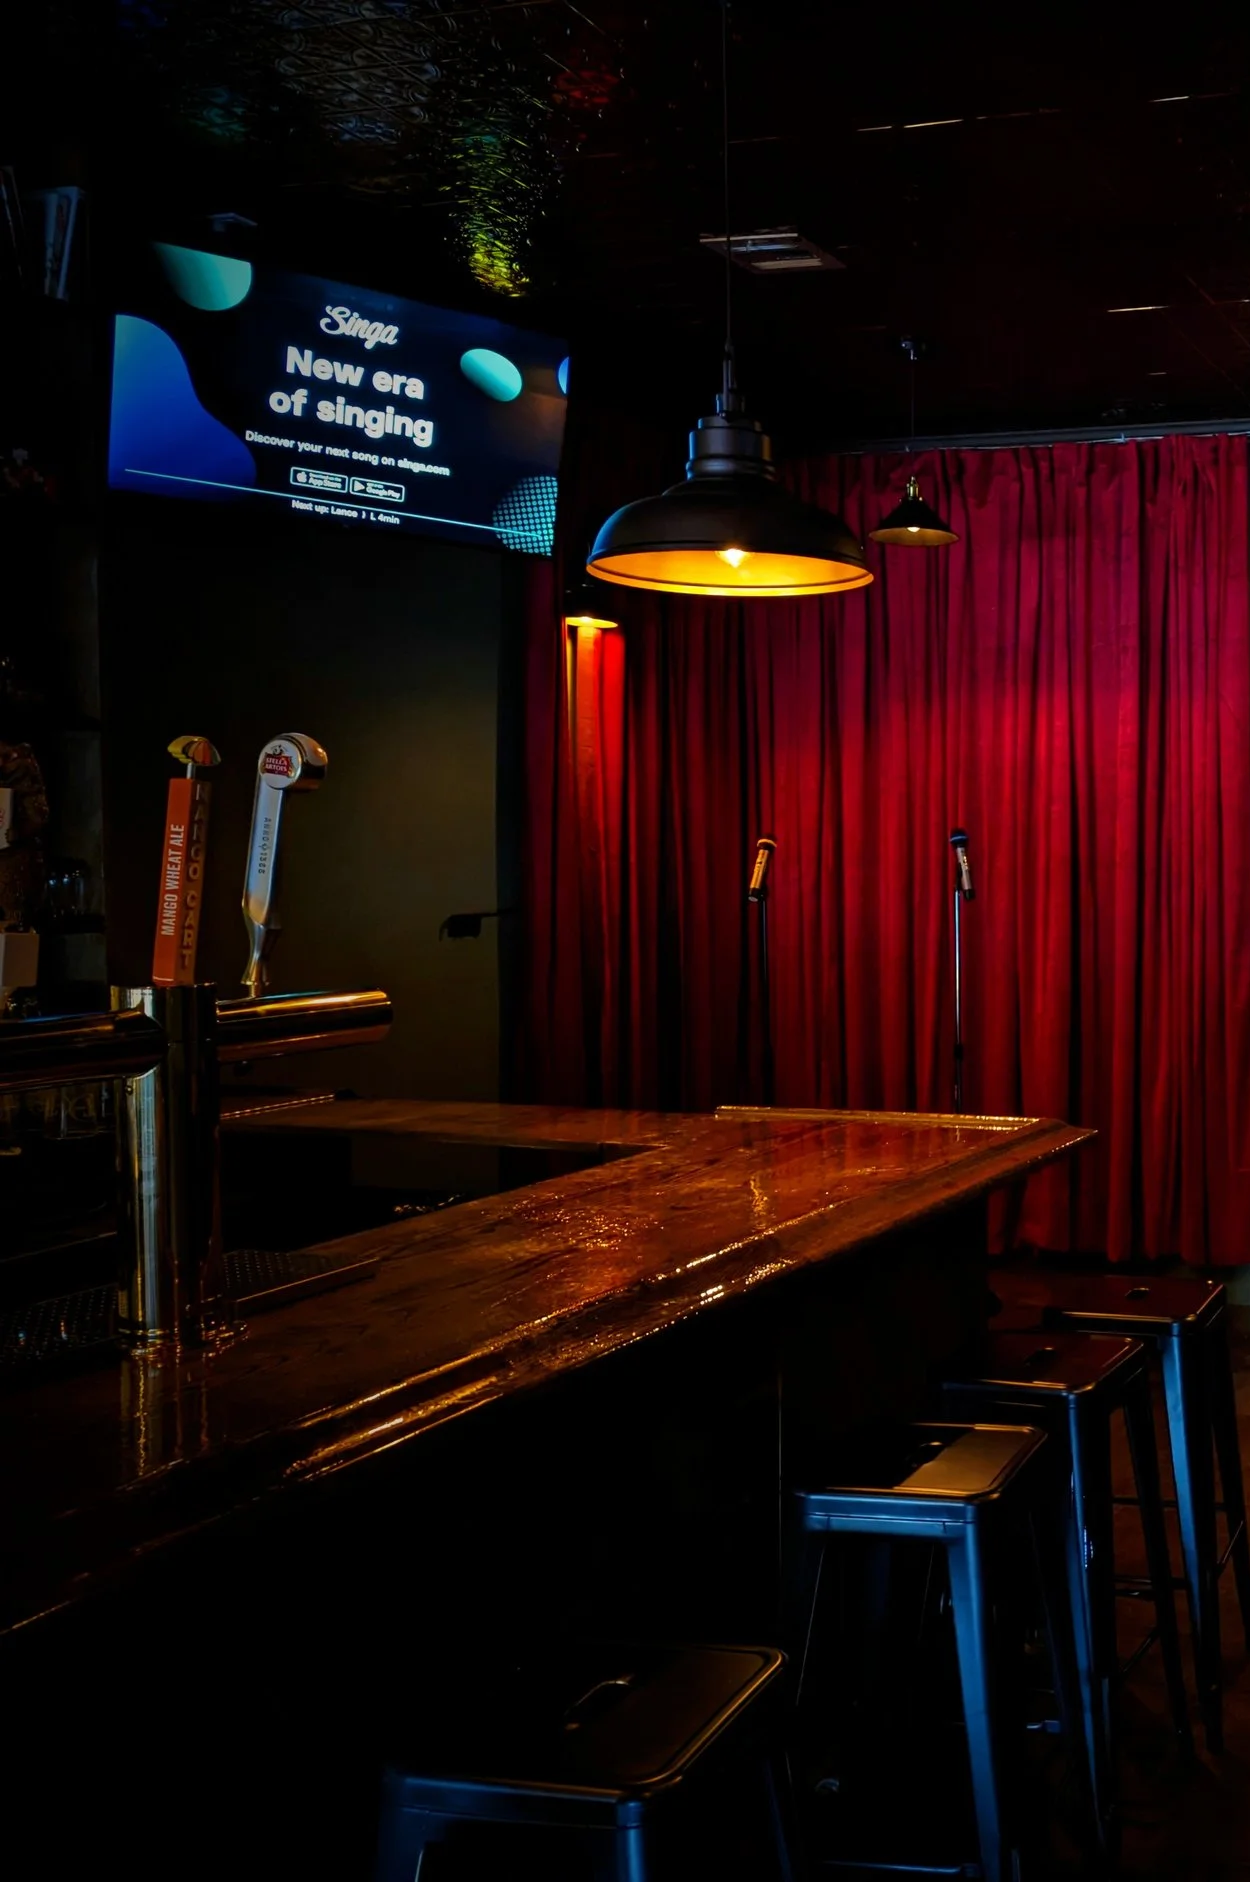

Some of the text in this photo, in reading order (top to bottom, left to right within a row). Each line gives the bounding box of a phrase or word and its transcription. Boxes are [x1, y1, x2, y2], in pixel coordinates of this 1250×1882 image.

[319, 305, 399, 350] Singa
[285, 345, 425, 400] New era
[268, 388, 434, 447] of singing
[245, 430, 450, 476] Discover your next song on singa.com
[291, 499, 313, 511] Next
[331, 506, 358, 518] Lance
[160, 824, 185, 937] MANGO WHEAT ALE
[181, 890, 199, 967] CART
